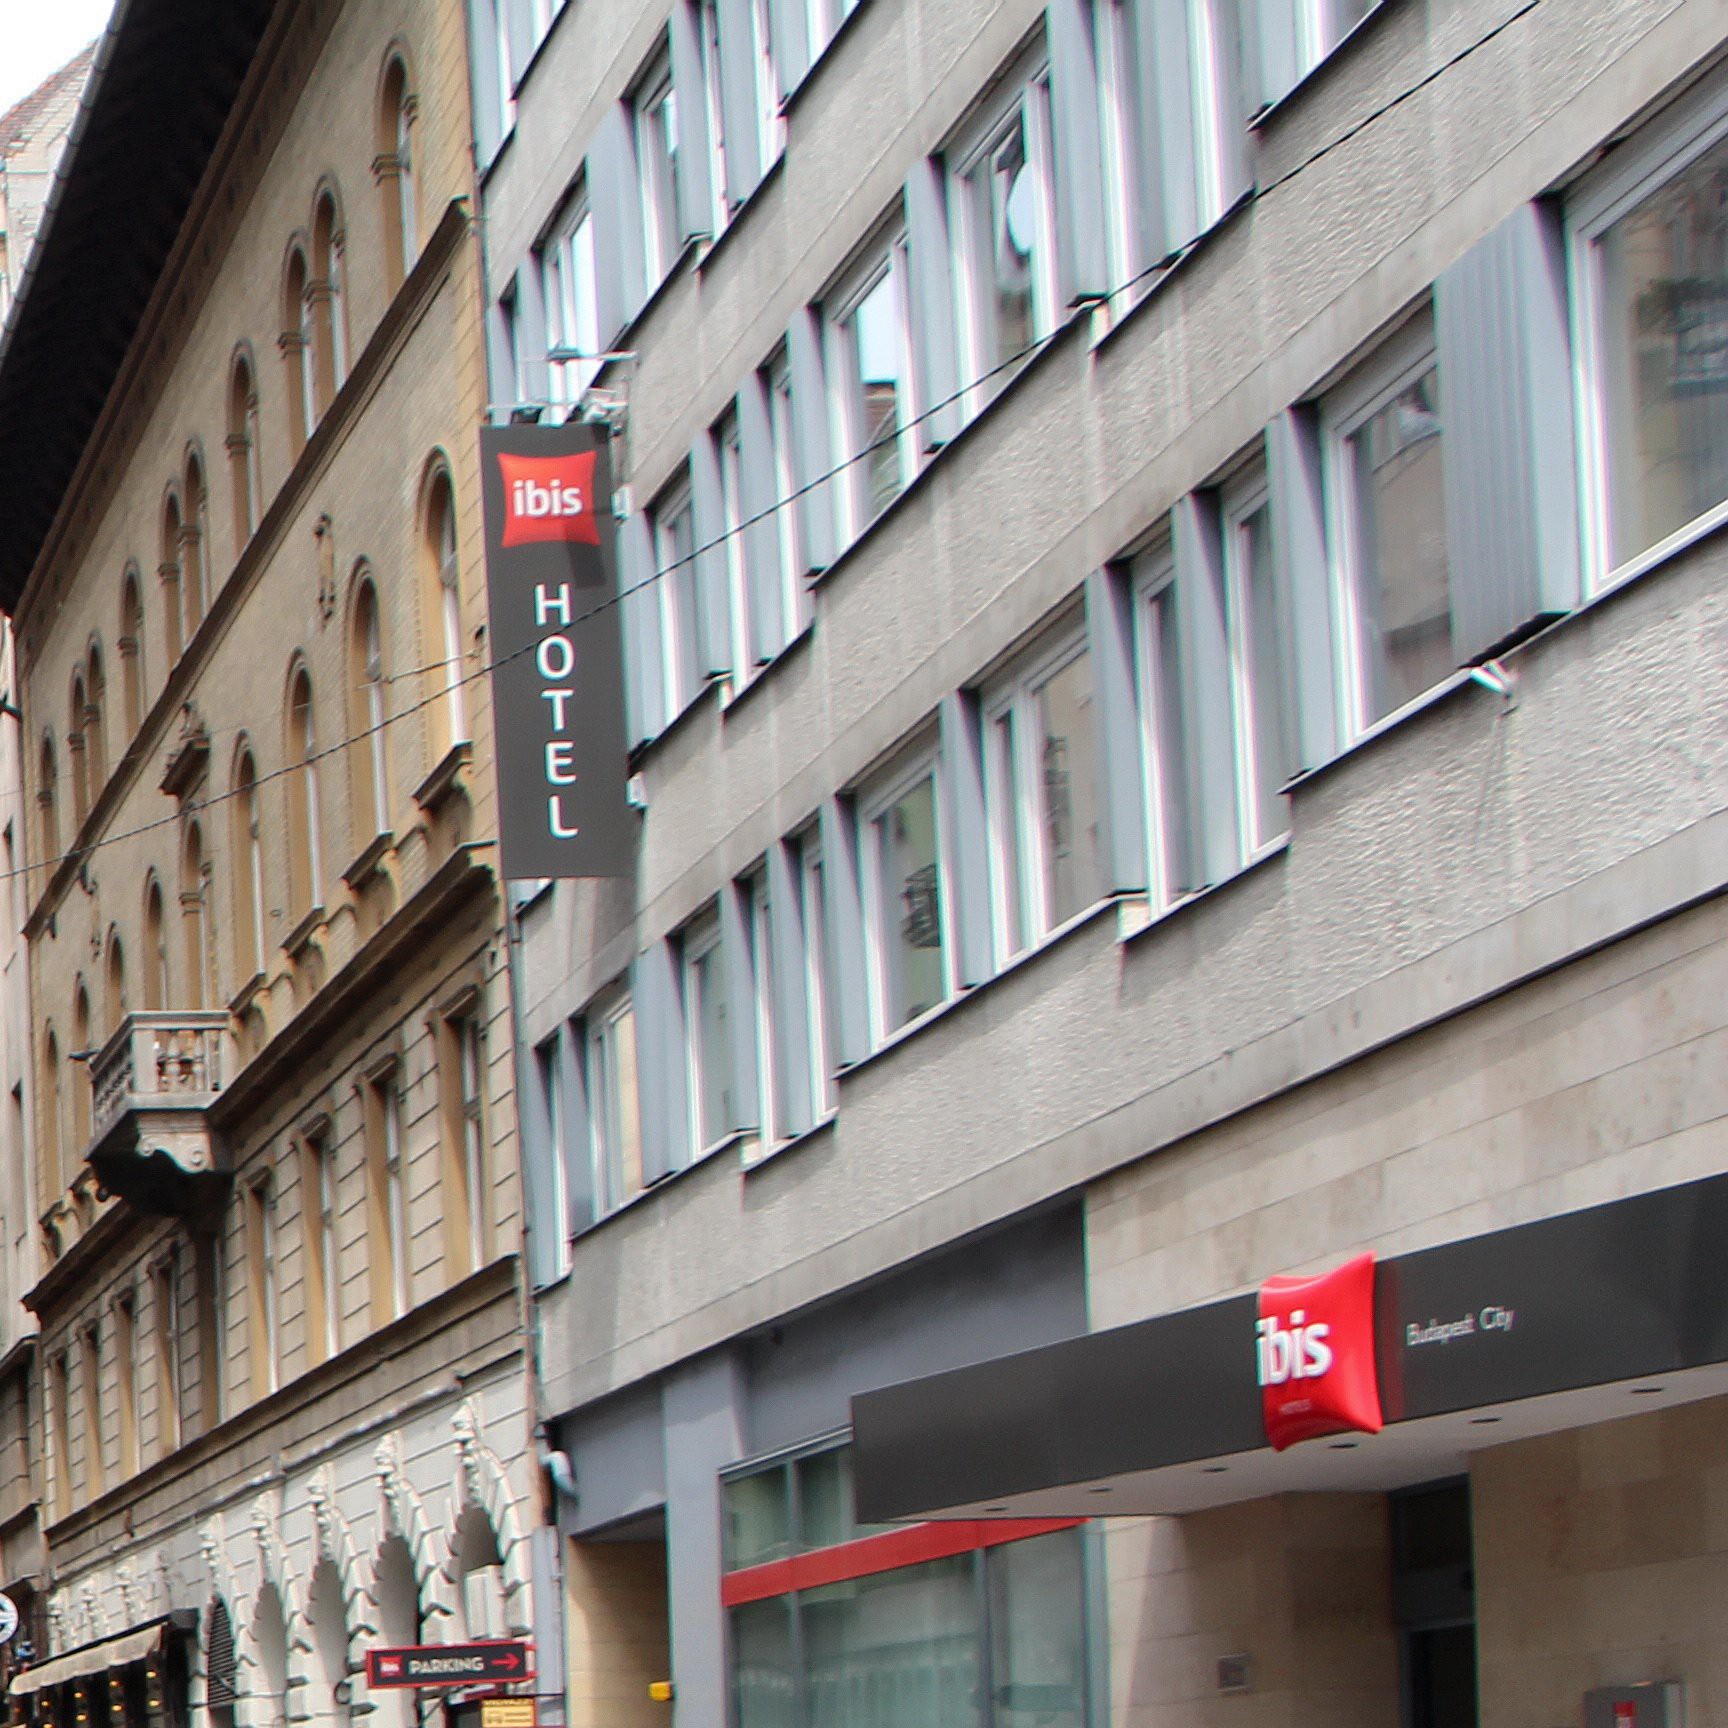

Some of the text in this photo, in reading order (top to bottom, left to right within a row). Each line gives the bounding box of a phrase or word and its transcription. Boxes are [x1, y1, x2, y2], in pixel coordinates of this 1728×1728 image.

[511, 480, 583, 518] ibis
[533, 582, 579, 839] HOTEL
[1406, 1305, 1515, 1346] Budapest City
[1255, 1309, 1334, 1386] ibis
[408, 1656, 485, 1675] PARKING
